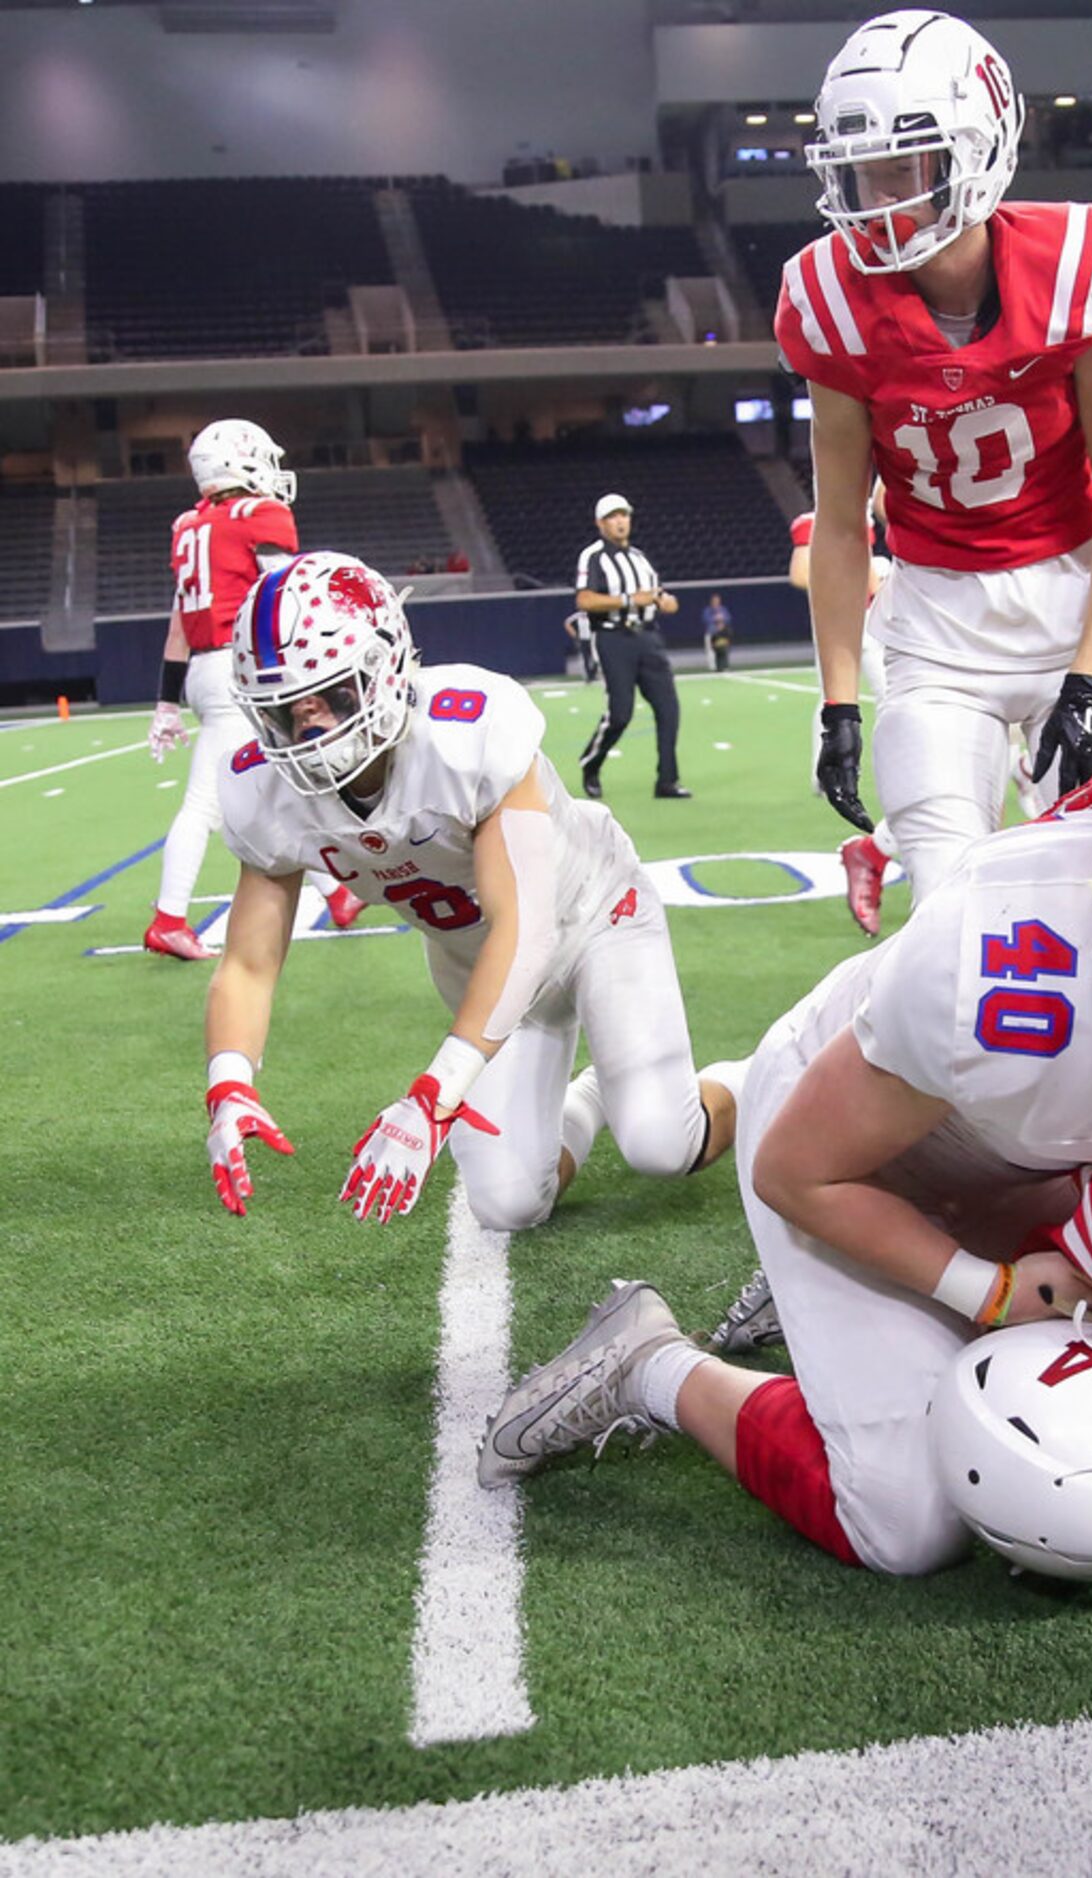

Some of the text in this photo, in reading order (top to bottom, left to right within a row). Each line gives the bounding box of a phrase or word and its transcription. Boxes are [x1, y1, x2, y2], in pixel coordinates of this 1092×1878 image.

[894, 403, 1035, 509] 10
[177, 523, 214, 614] 21
[429, 688, 488, 723] 8
[320, 846, 359, 881] C
[384, 877, 483, 931] 8
[973, 919, 1078, 1059] 40
